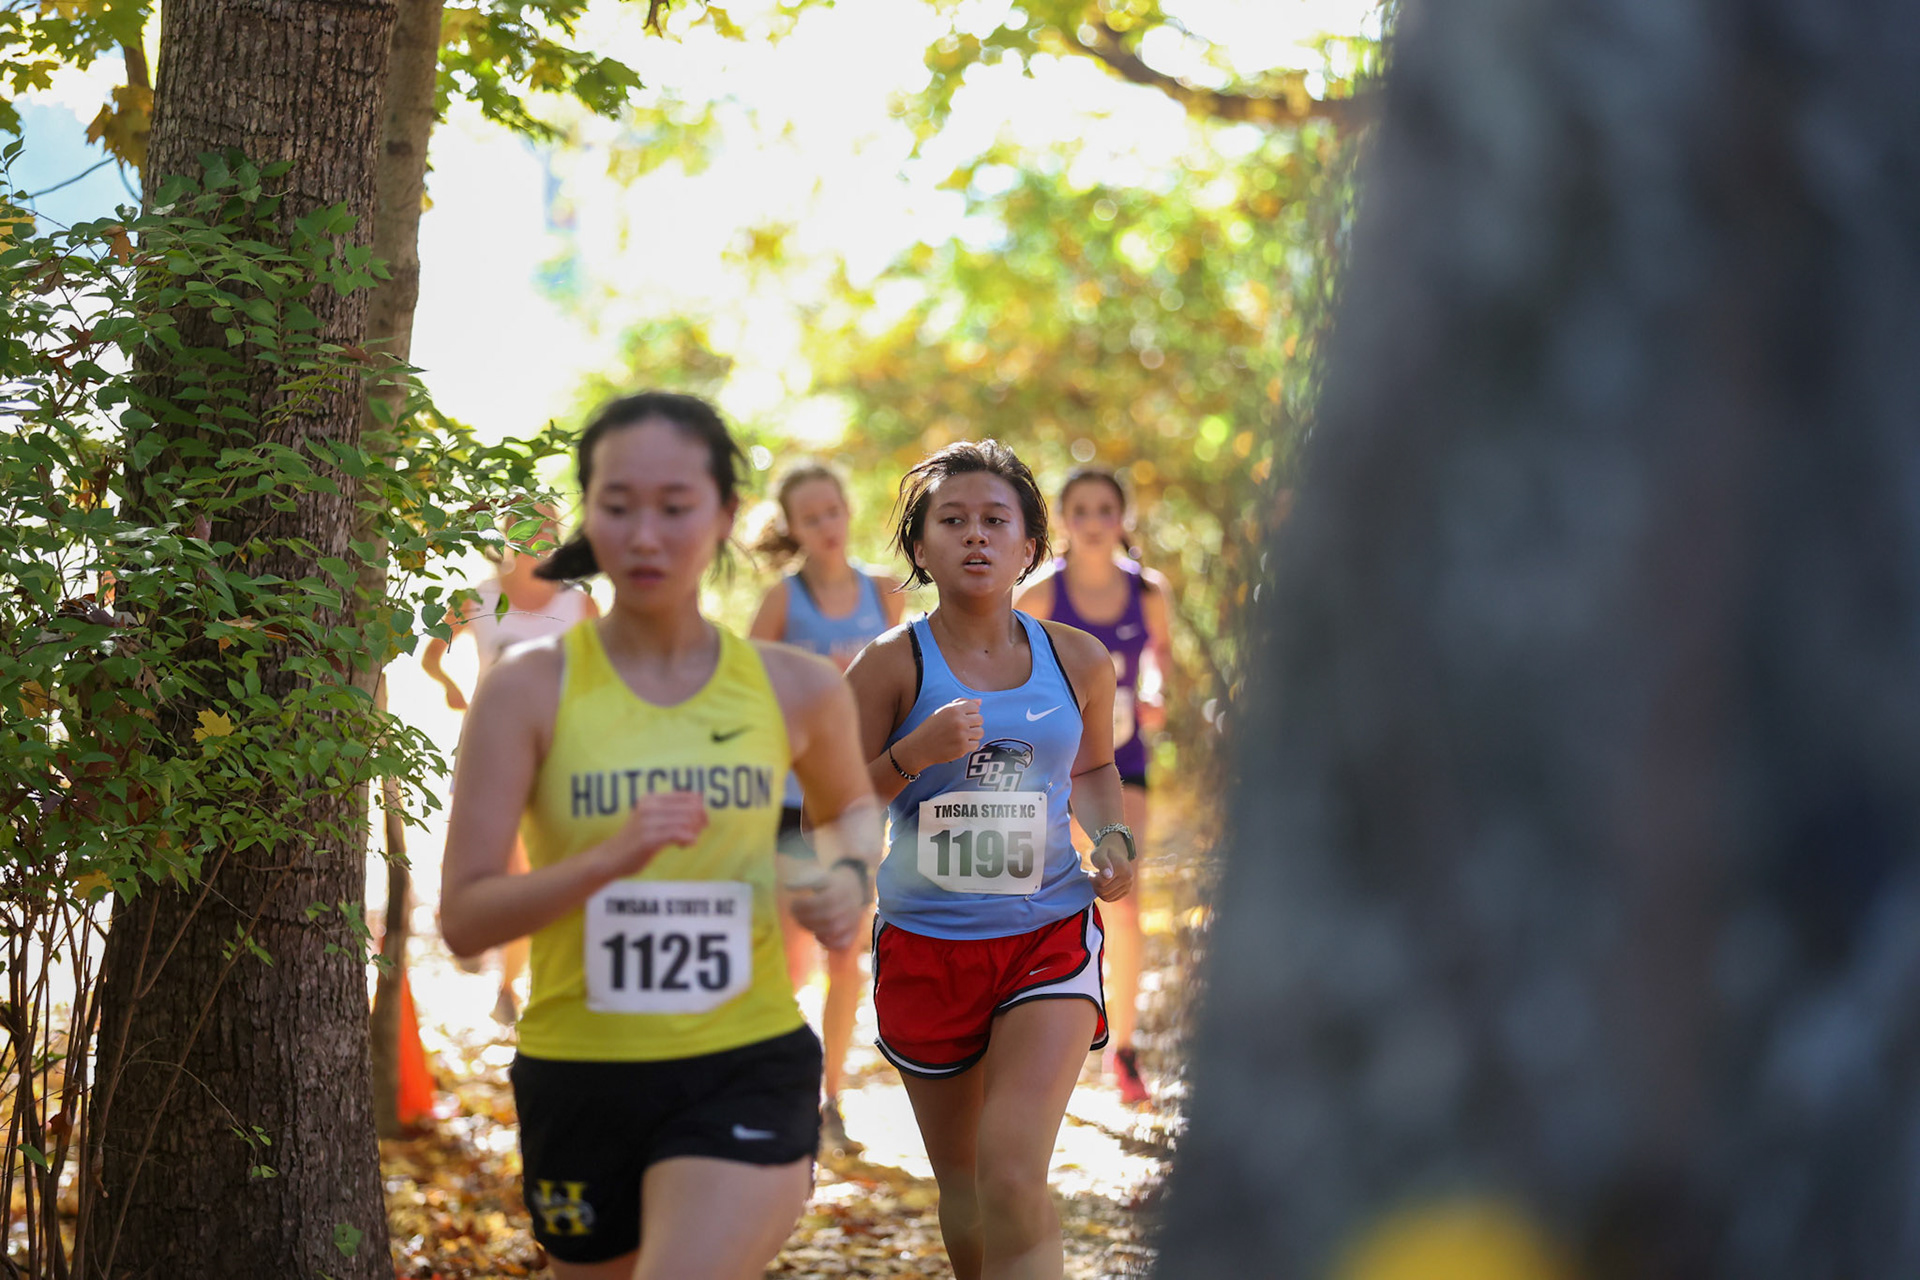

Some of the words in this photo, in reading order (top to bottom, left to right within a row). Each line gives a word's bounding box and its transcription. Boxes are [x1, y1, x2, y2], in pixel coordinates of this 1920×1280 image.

[570, 765, 774, 818] HUTCHISON
[934, 804, 979, 818] TMSAA
[981, 804, 1017, 819] STATE
[1019, 804, 1036, 819] XC
[930, 829, 1034, 879] 1195
[601, 931, 731, 991] 1125
